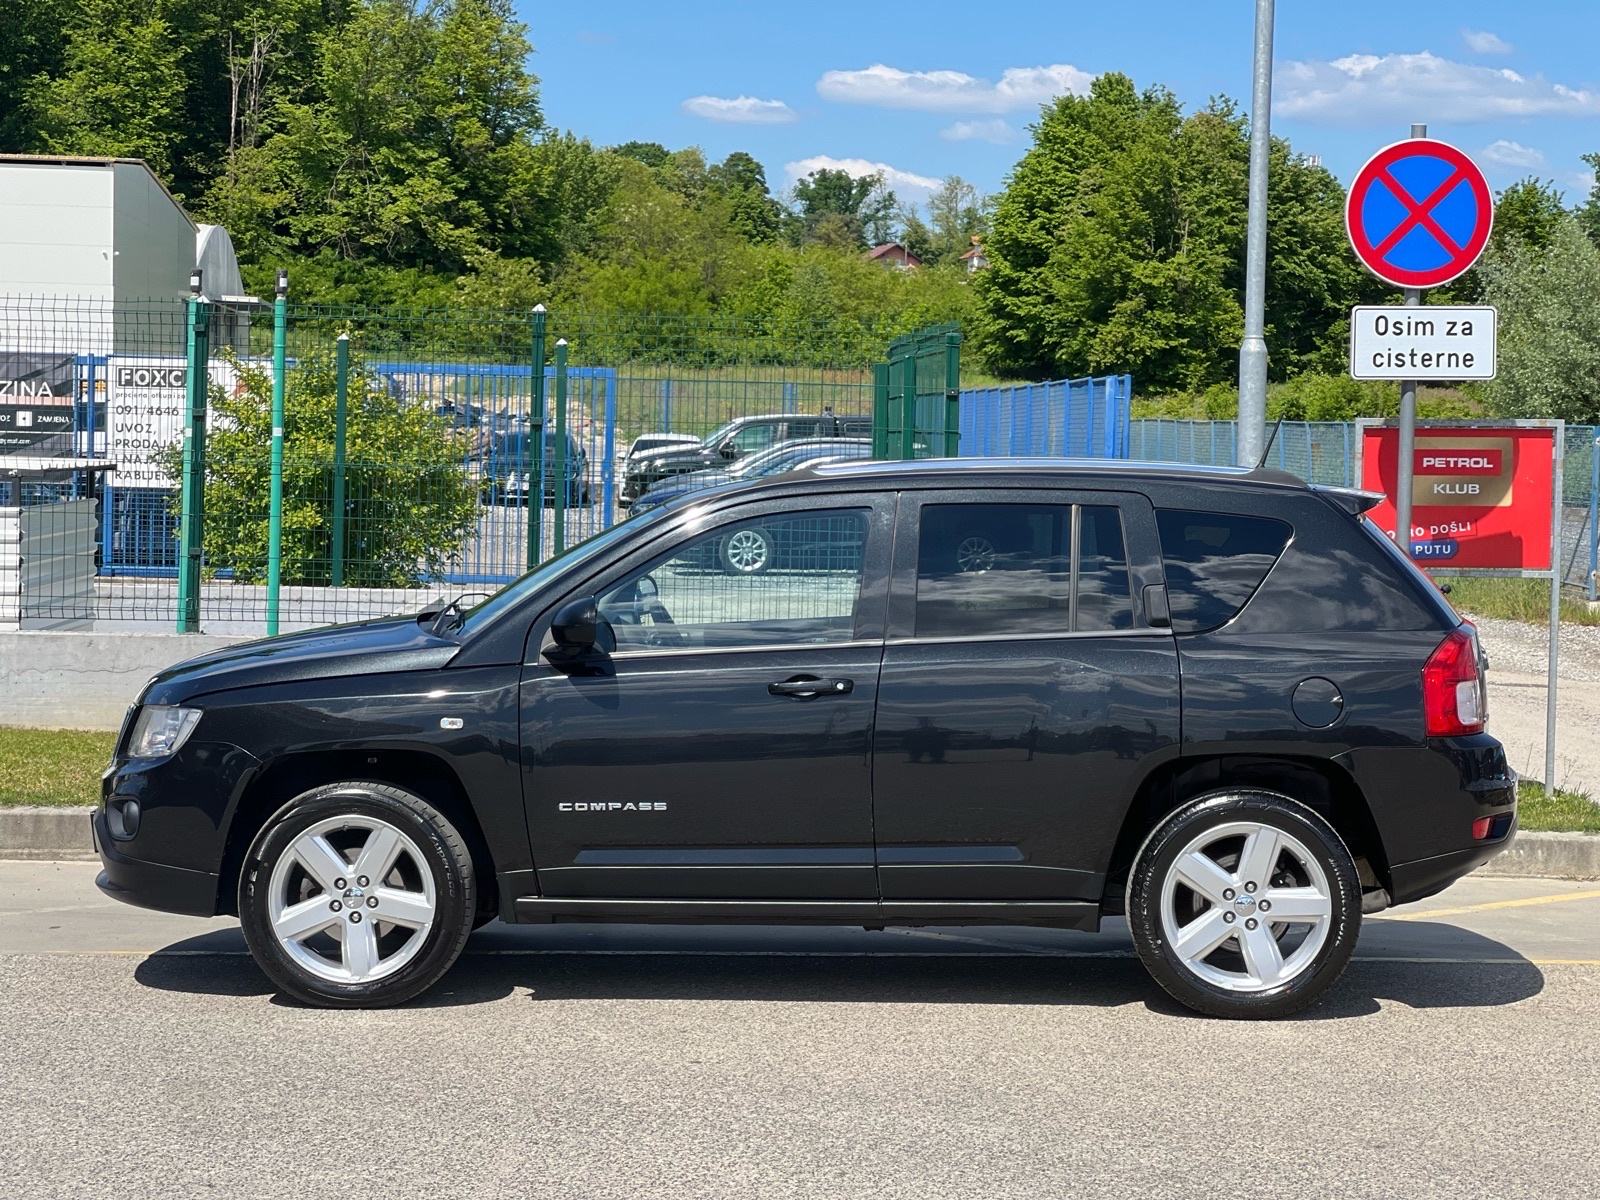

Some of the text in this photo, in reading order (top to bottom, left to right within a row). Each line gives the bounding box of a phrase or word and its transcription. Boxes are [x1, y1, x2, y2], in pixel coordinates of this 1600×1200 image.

[1374, 315, 1474, 337] Osim za
[1372, 347, 1475, 368] cisterne
[118, 368, 213, 388] FOXC
[0, 380, 54, 397] ZINA
[115, 404, 179, 418] 091/4646
[115, 423, 156, 435] UVOZ,
[122, 453, 160, 465] NAJ
[1422, 456, 1494, 468] PETROL
[1433, 483, 1481, 495] KLUB
[1430, 521, 1471, 535] DOŠLI
[1415, 544, 1451, 555] PUTU
[558, 802, 668, 812] COMPASS
